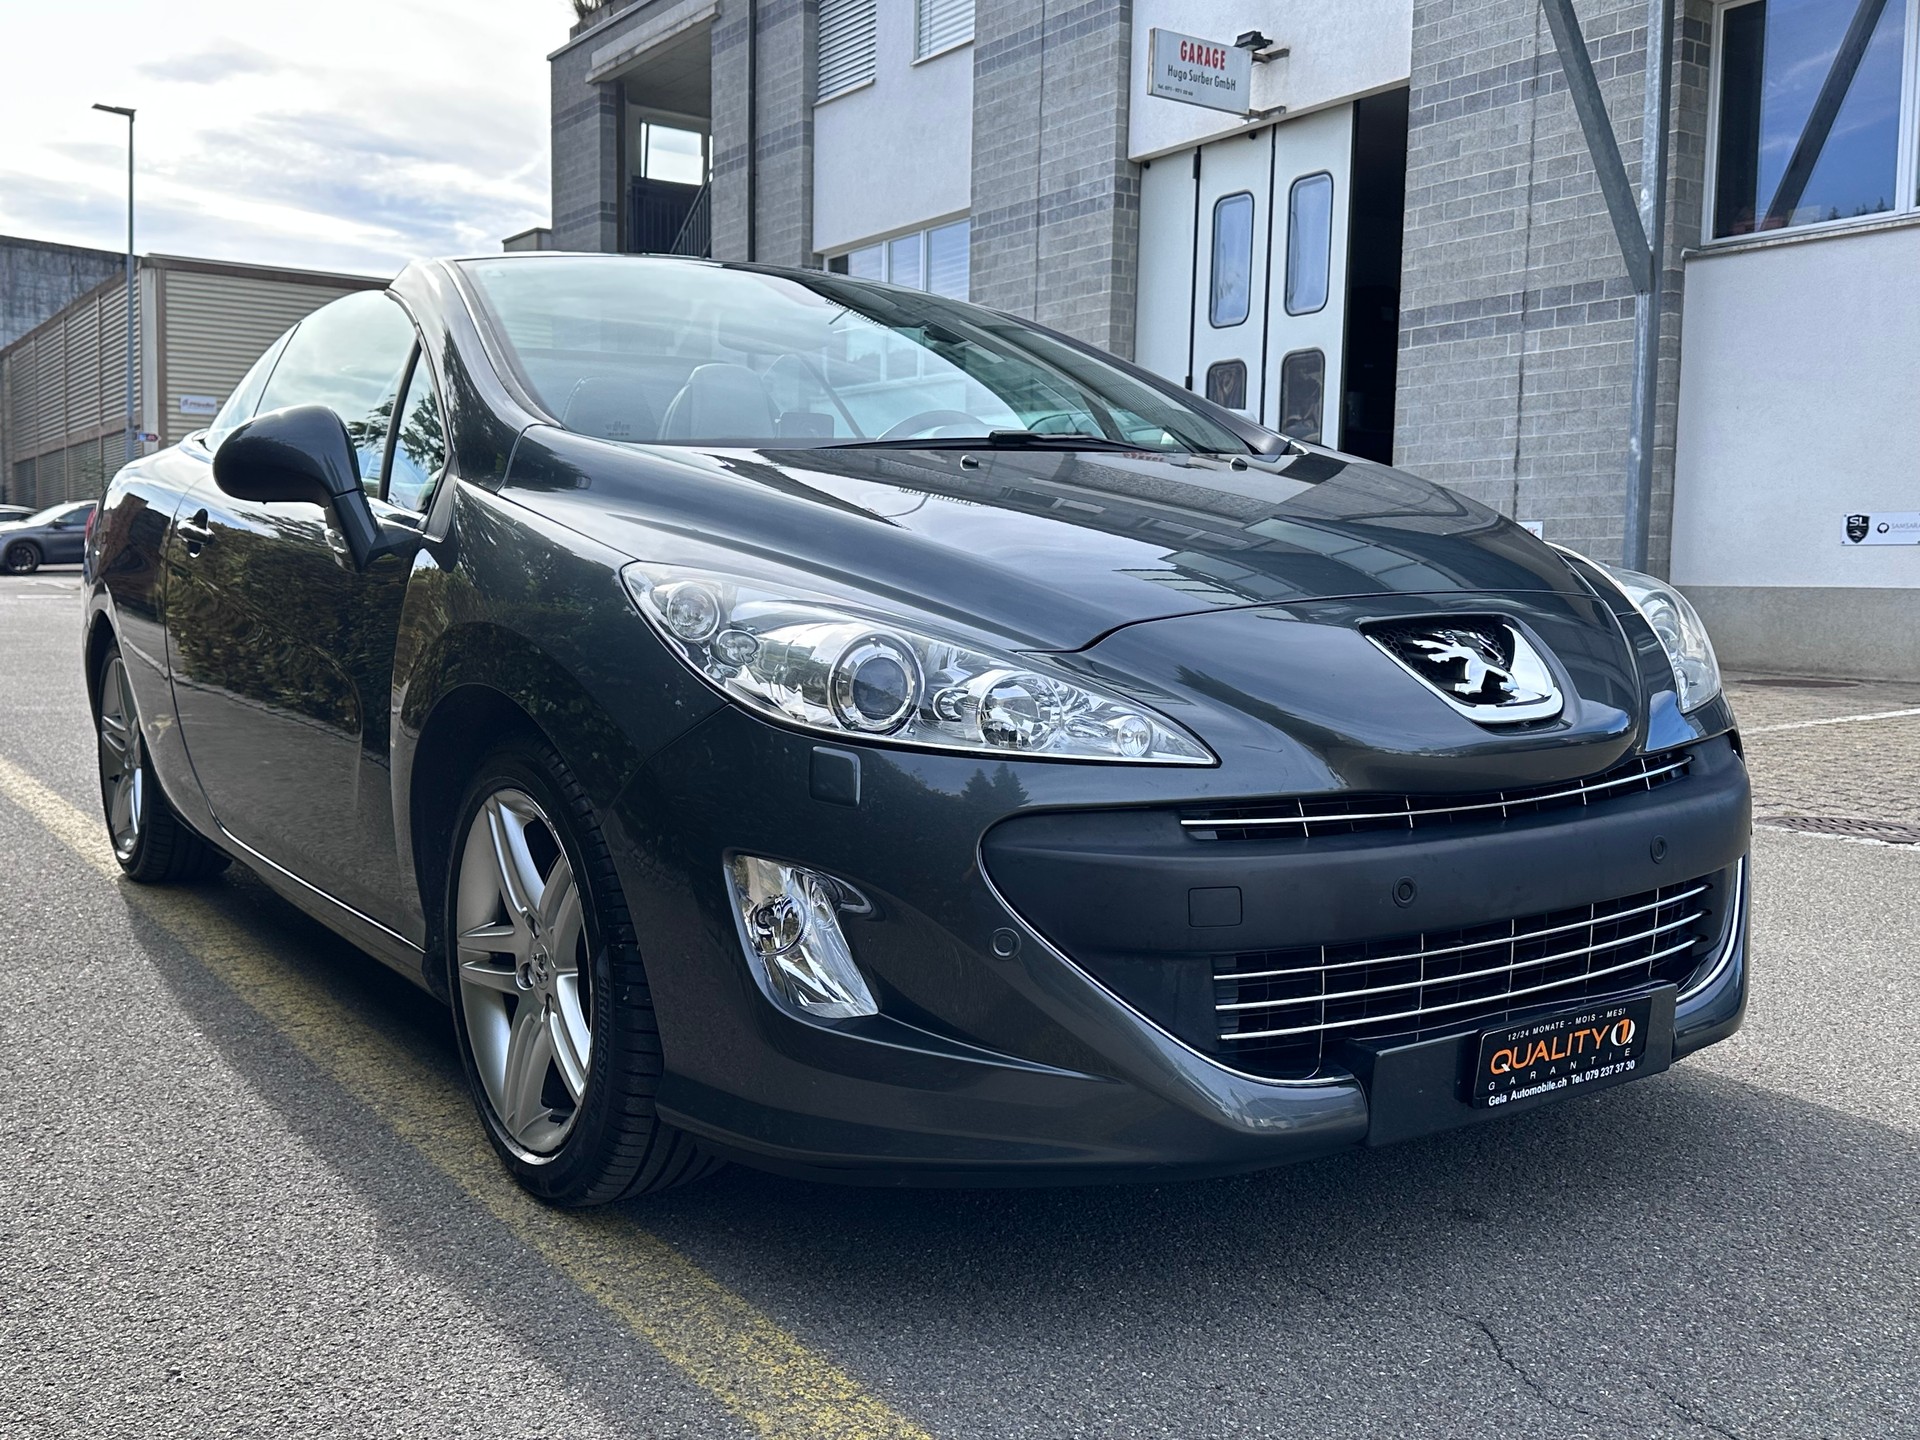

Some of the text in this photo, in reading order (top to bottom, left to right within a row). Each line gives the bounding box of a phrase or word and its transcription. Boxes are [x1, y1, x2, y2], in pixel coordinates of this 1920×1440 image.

[1180, 40, 1226, 70] GARAGE
[1167, 64, 1237, 91] Hugo Surber GmbH
[1849, 517, 1867, 527] SL
[1507, 1029, 1529, 1042] 12/24
[1532, 1020, 1565, 1035] MONATE
[1575, 1013, 1596, 1025] MOIS
[1490, 1024, 1610, 1075] QUALITY
[1510, 1077, 1567, 1101] Automobile.ch
[1571, 1072, 1585, 1085] Tel.
[1585, 1068, 1599, 1081] 079
[1600, 1065, 1614, 1077] 237
[1615, 1061, 1625, 1073] 37
[1625, 1059, 1636, 1071] 30
